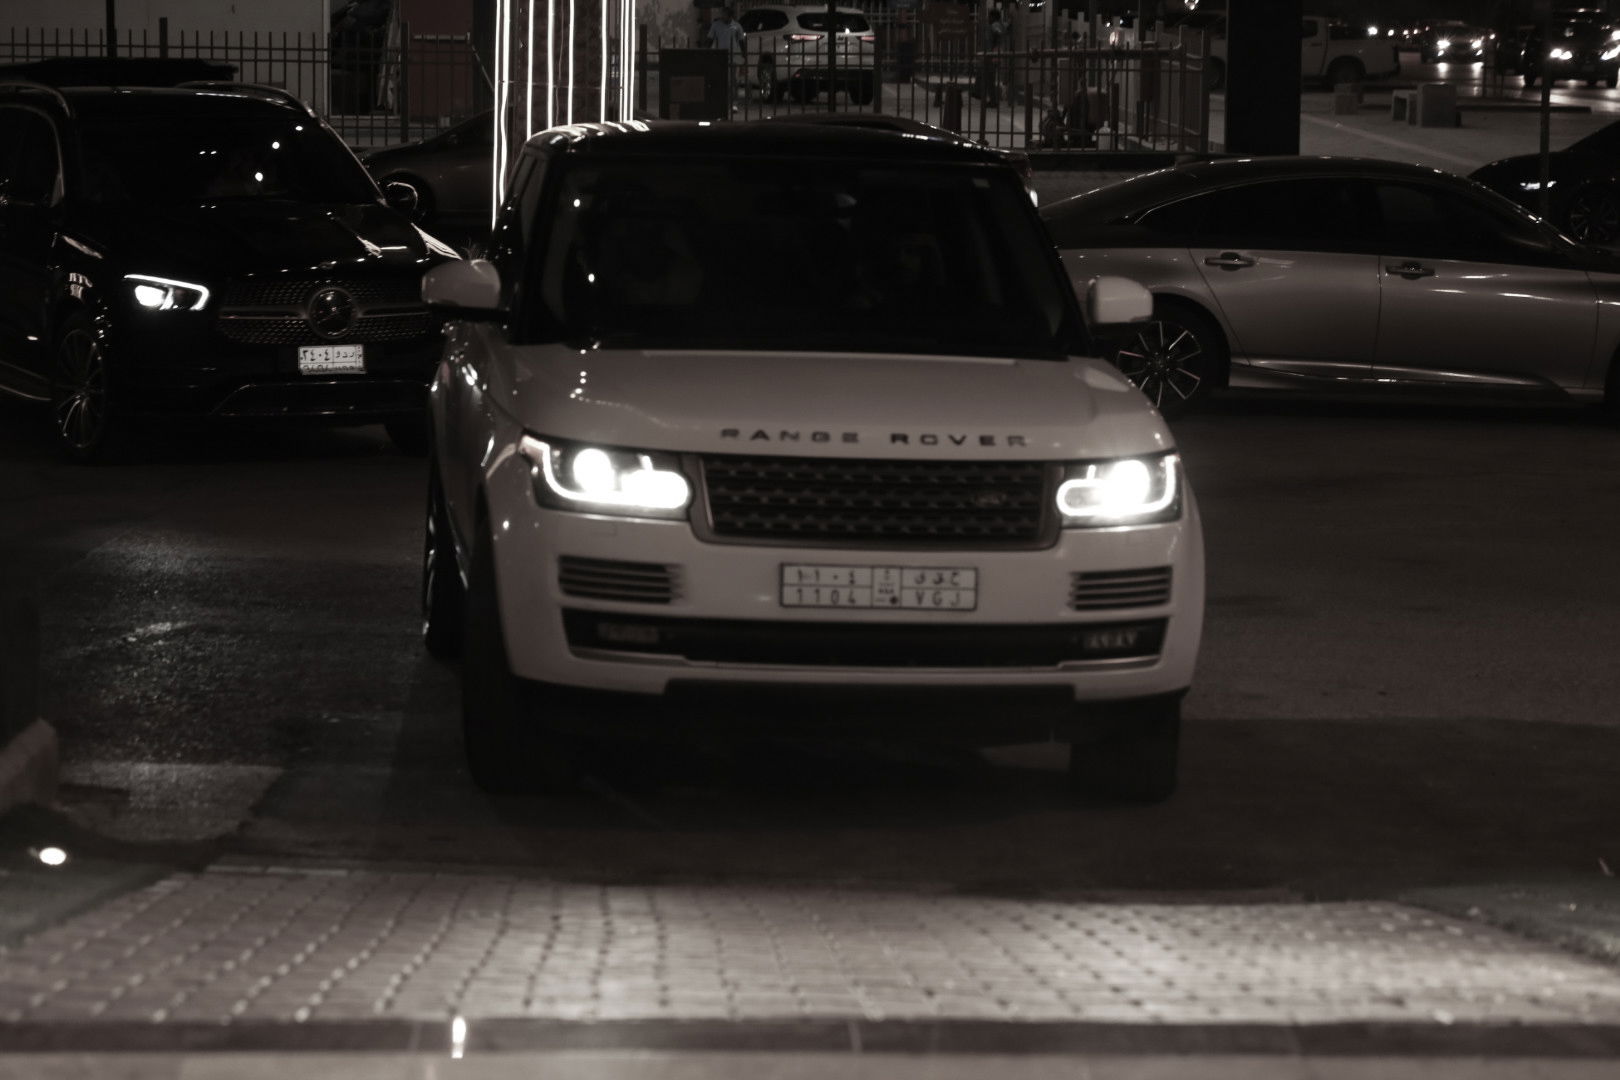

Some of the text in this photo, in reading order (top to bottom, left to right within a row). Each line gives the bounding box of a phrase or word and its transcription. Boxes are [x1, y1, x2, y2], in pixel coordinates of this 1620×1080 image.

[720, 428, 1028, 447] RANGE ROVER
[796, 588, 856, 606] 1104
